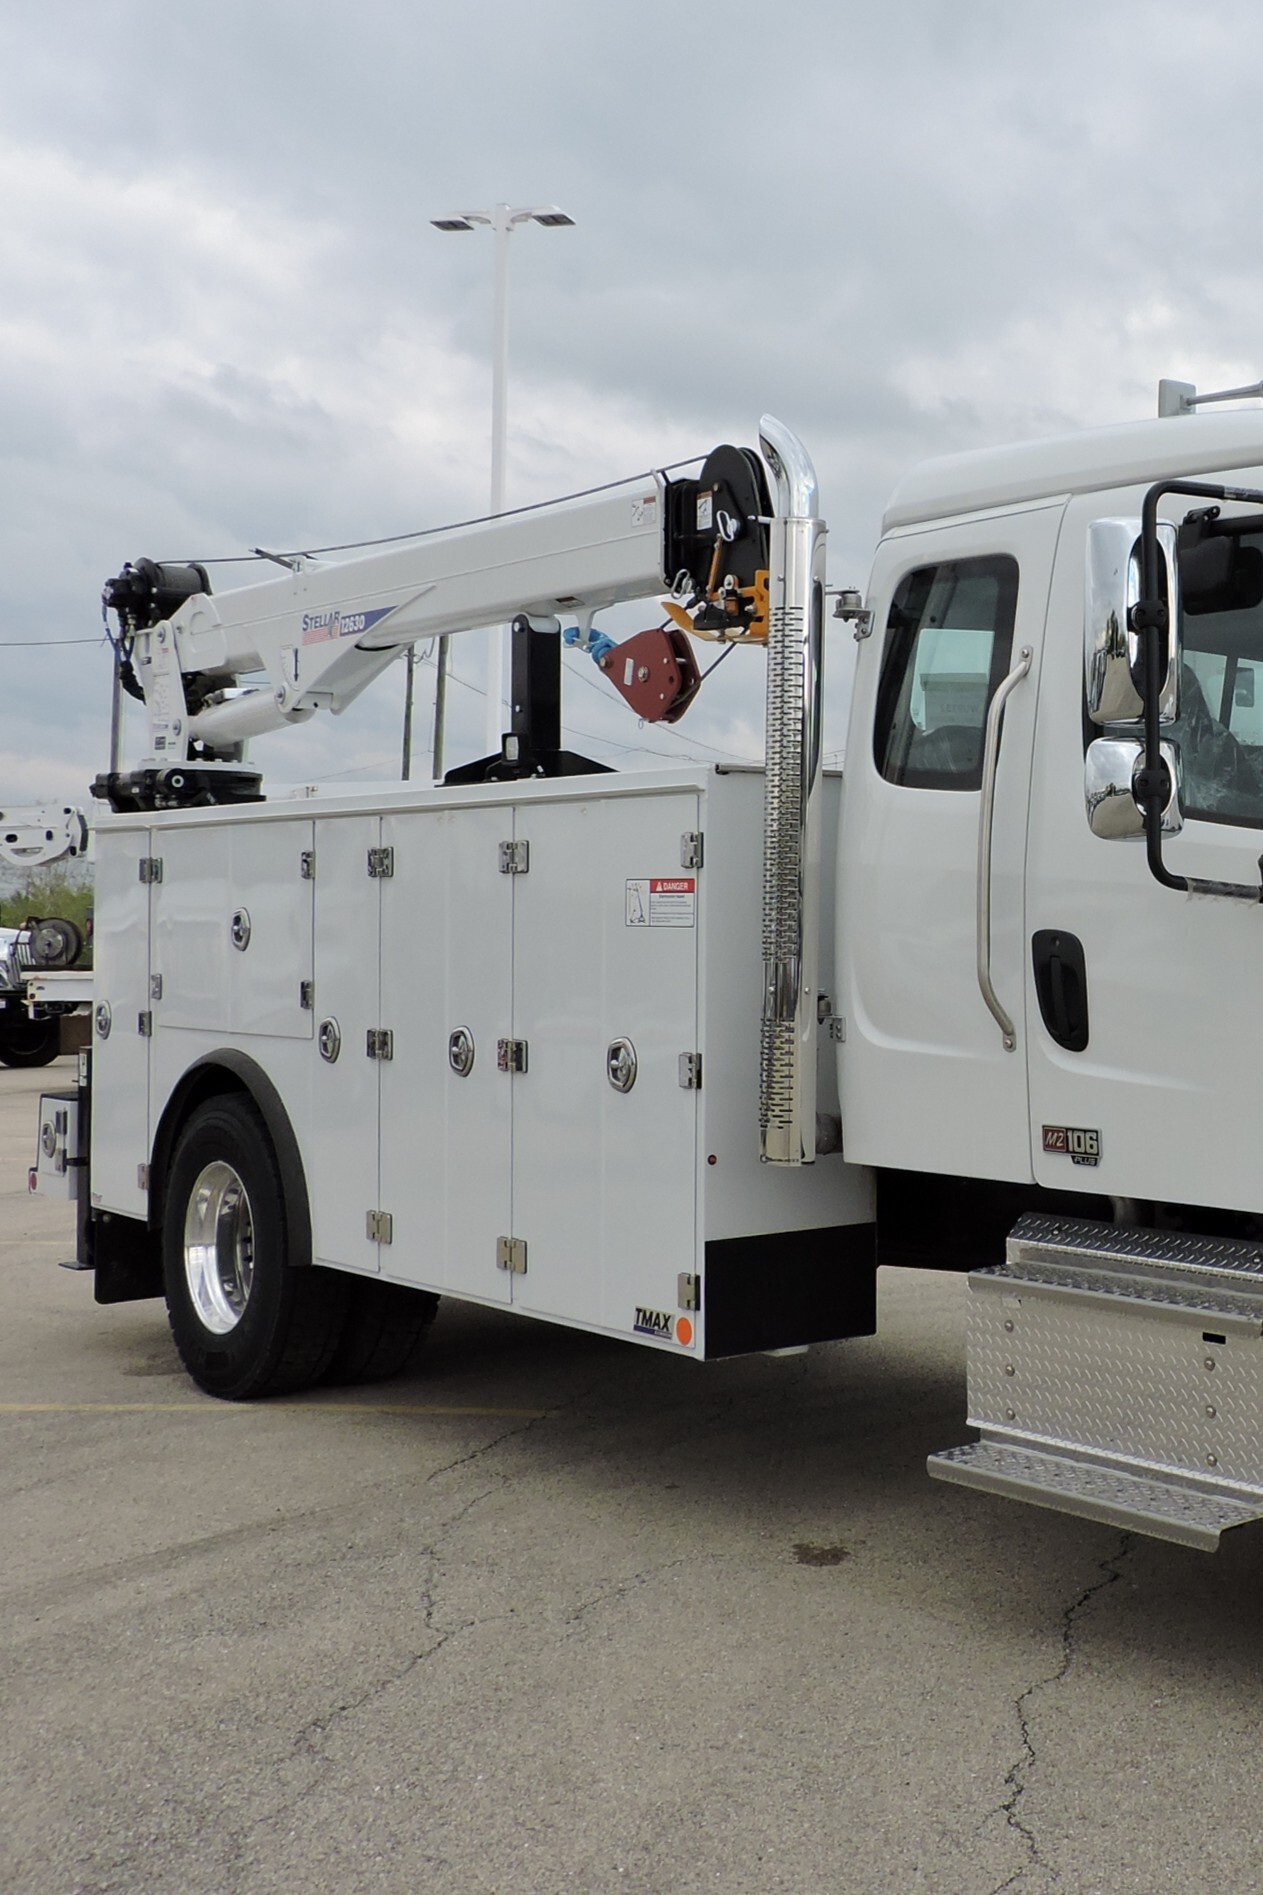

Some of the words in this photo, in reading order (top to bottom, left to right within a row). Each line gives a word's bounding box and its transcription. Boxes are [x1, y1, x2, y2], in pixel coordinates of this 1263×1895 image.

[303, 611, 340, 632] STELLAR
[341, 614, 366, 633] 12630
[663, 882, 689, 891] DANGER
[1045, 1131, 1064, 1147] M2
[1067, 1129, 1099, 1154] 106
[1074, 1156, 1097, 1166] PLUS
[635, 1307, 672, 1332] TMAX
